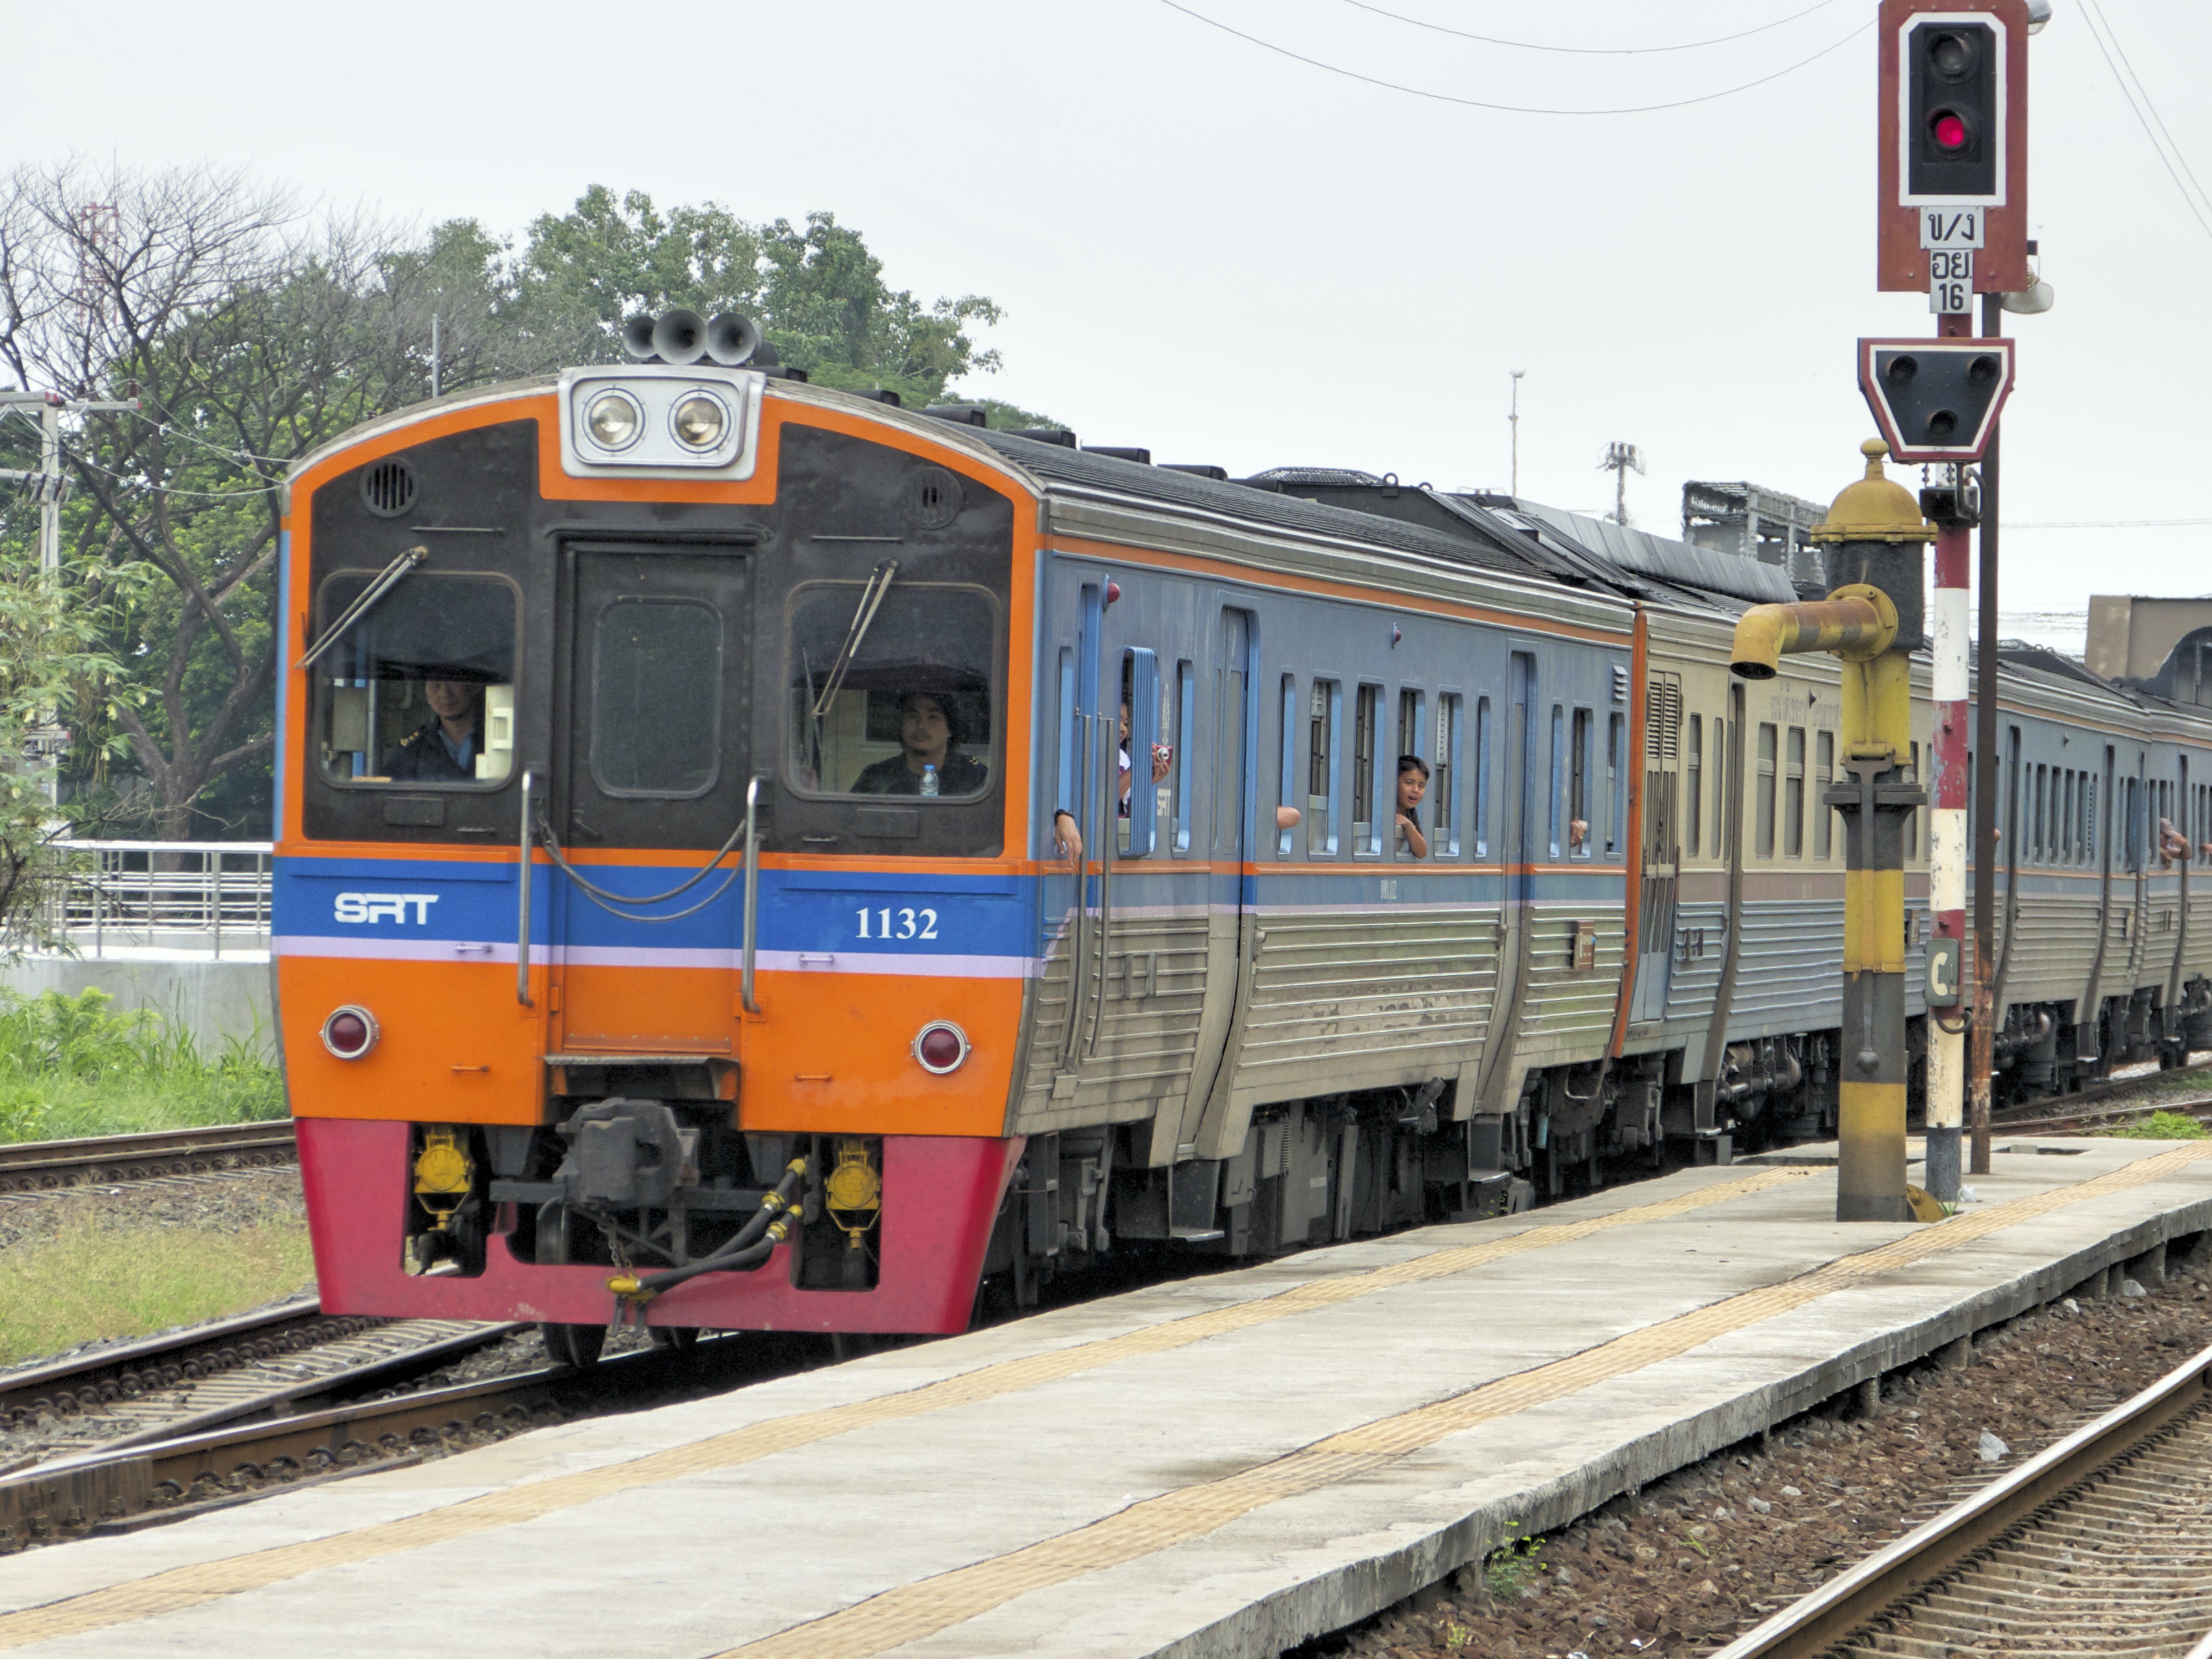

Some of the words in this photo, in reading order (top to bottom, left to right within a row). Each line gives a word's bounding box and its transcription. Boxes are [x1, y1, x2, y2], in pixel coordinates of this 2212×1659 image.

[1938, 283, 1964, 311] 16
[334, 892, 440, 925] SRT
[855, 907, 938, 939] 1132
